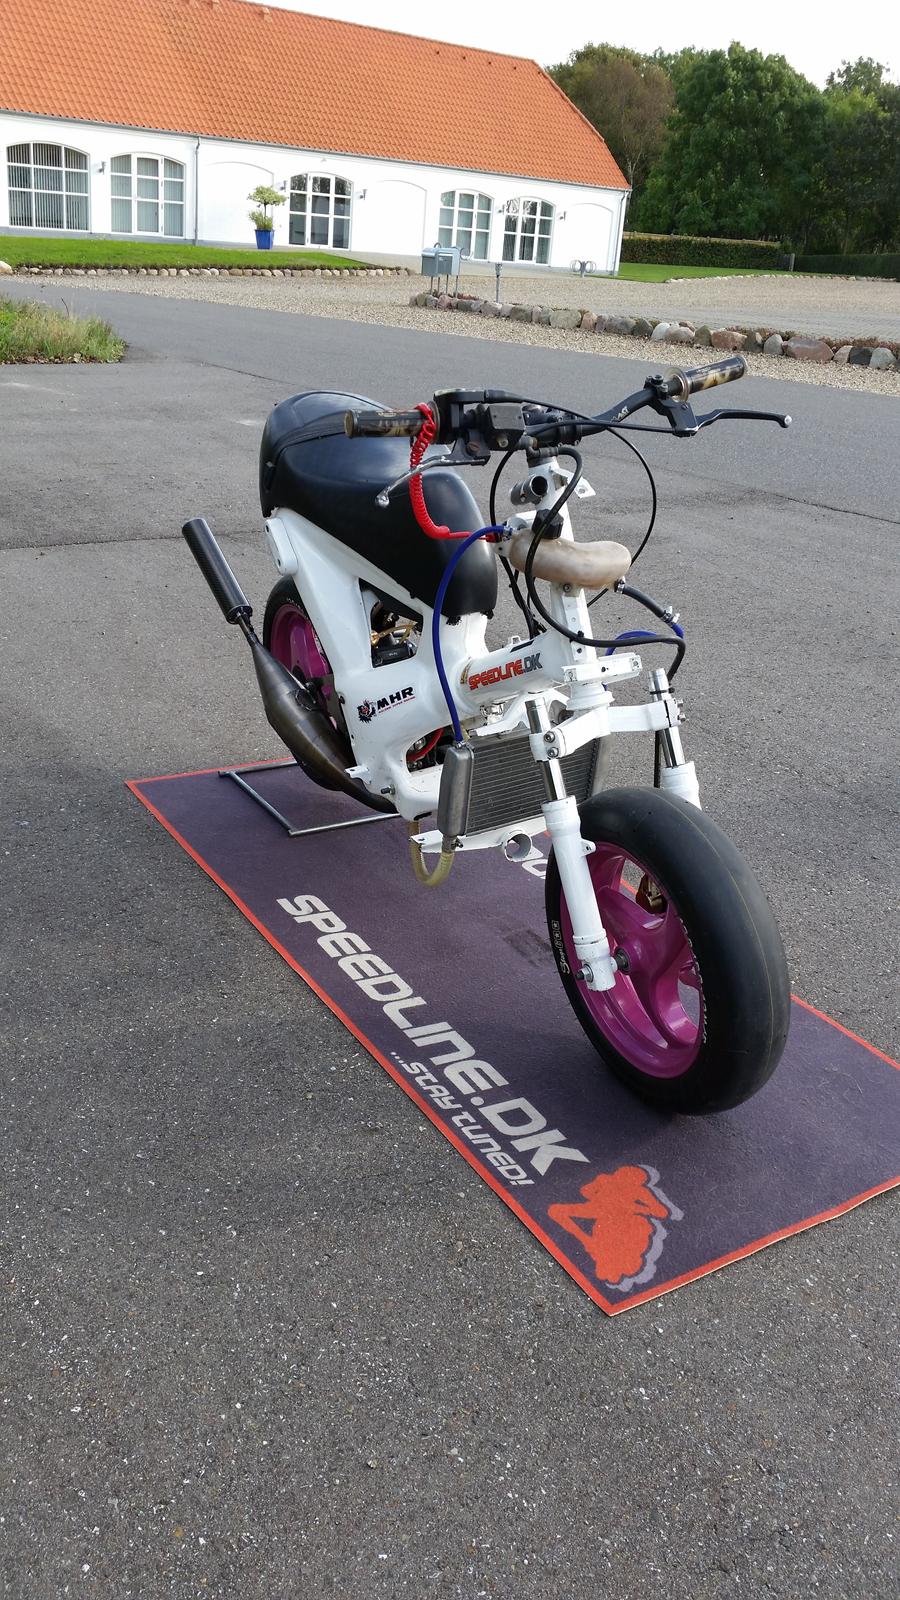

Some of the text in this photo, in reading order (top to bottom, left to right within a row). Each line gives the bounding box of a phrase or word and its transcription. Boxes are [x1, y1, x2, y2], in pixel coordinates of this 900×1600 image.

[377, 686, 414, 710] MHR
[468, 653, 543, 690] SPEEDLINE.DK
[276, 894, 590, 1176] SPEEDLINE.DK
[451, 1111, 535, 1186] TUNED!
